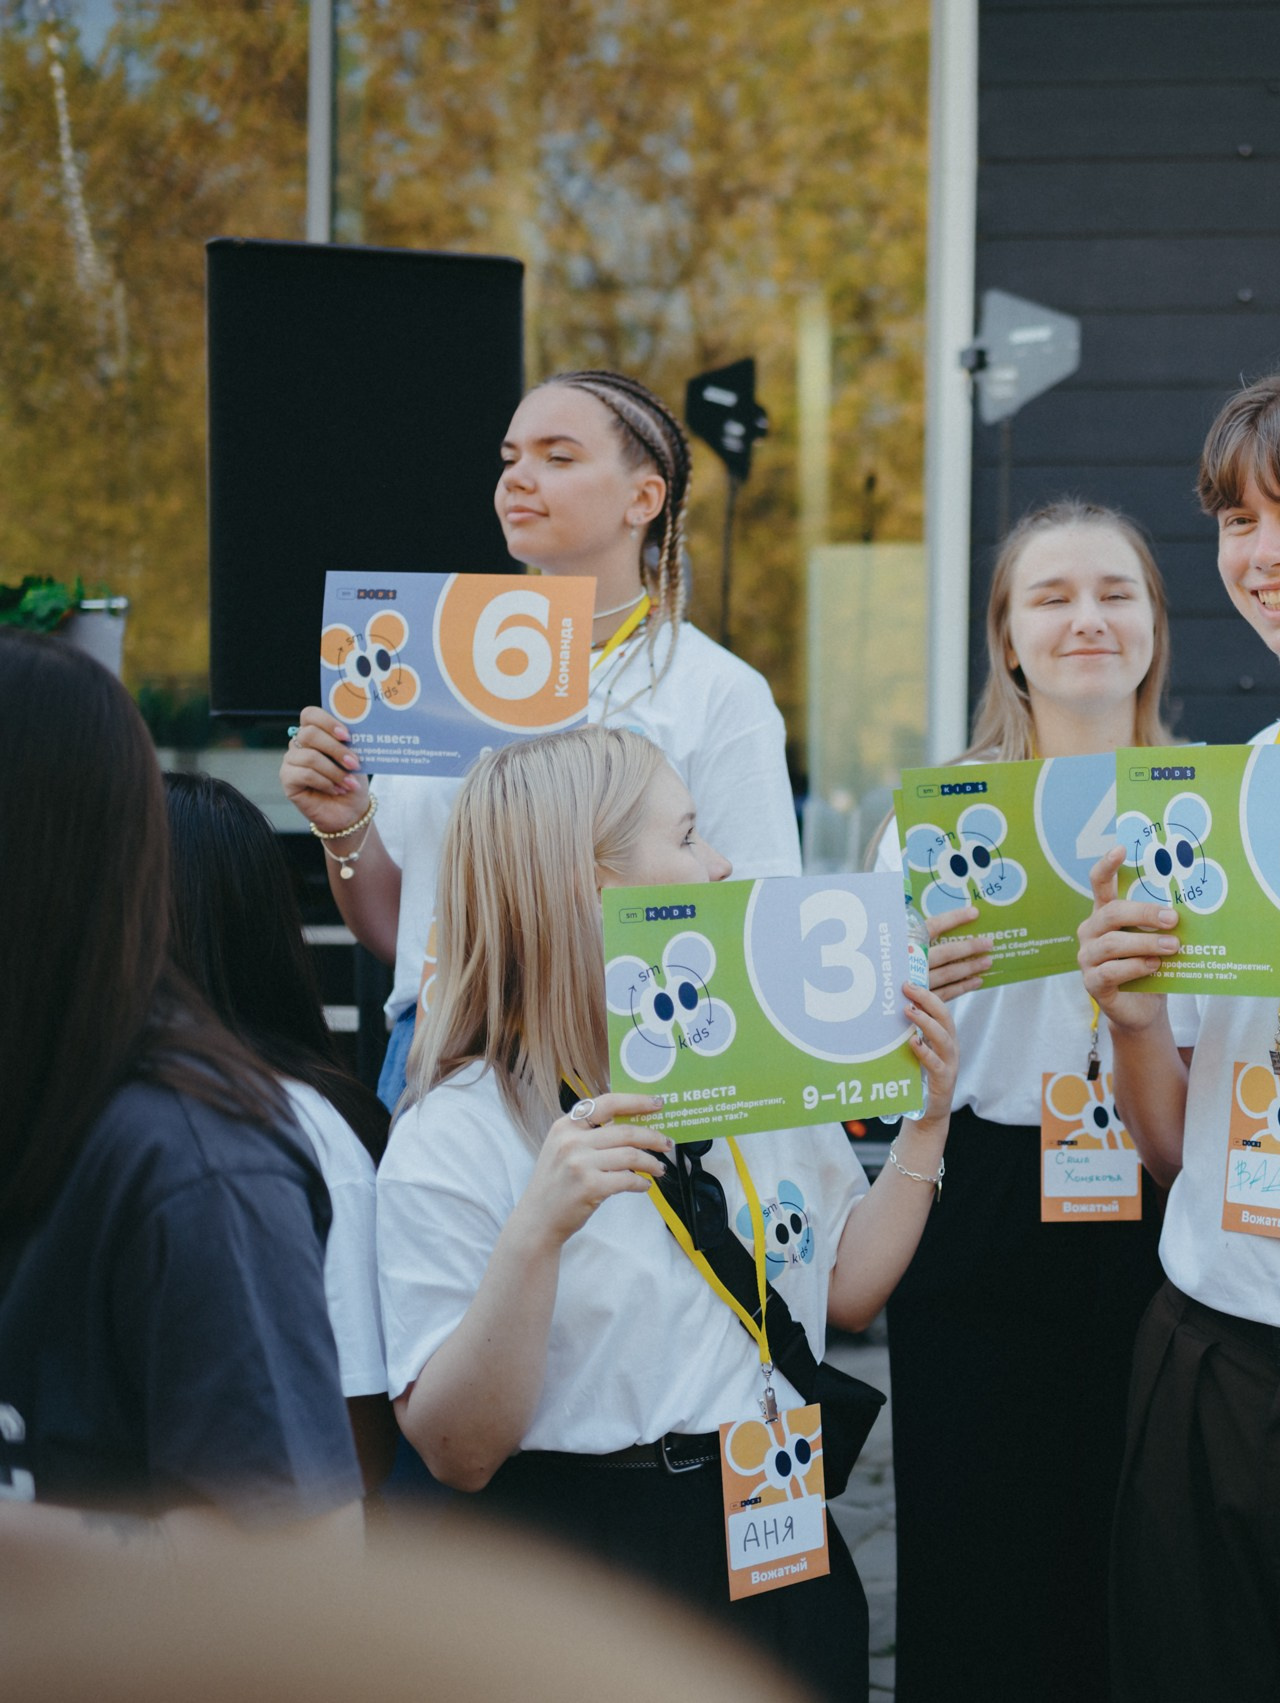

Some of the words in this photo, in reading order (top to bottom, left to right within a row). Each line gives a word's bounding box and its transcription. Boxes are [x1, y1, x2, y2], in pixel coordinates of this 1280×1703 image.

[345, 633, 363, 645] sm
[473, 590, 551, 700] 6
[554, 617, 573, 697] Команда
[373, 687, 398, 702] kids
[352, 733, 373, 745] рта
[376, 734, 420, 745] квеста
[1152, 768, 1194, 779] KIDS
[942, 783, 985, 794] KIDS
[1143, 821, 1162, 838] sm
[935, 831, 956, 846] sm
[973, 882, 1002, 901] kids
[1175, 884, 1204, 905] kids
[647, 906, 694, 920] KIDS
[800, 889, 876, 1022] 3
[1178, 944, 1226, 956] квеста
[638, 964, 661, 983] sm
[878, 922, 896, 1016] Команда
[1162, 961, 1205, 969] профессий
[1206, 962, 1273, 972] СберМаркетинг,
[679, 1027, 710, 1050] kids
[683, 1085, 736, 1102] квеста
[869, 1078, 911, 1102] лет
[665, 1105, 714, 1119] профессий
[715, 1097, 786, 1113] СберМаркетинг,
[667, 1120, 679, 1128] же
[681, 1117, 710, 1126] пошло
[724, 1111, 748, 1121] так?»
[762, 1203, 778, 1218] sm
[1062, 1200, 1120, 1214] Вожатый
[792, 1246, 808, 1264] kids
[743, 1515, 795, 1553] АНЯ
[751, 1557, 808, 1585] Вожатый
